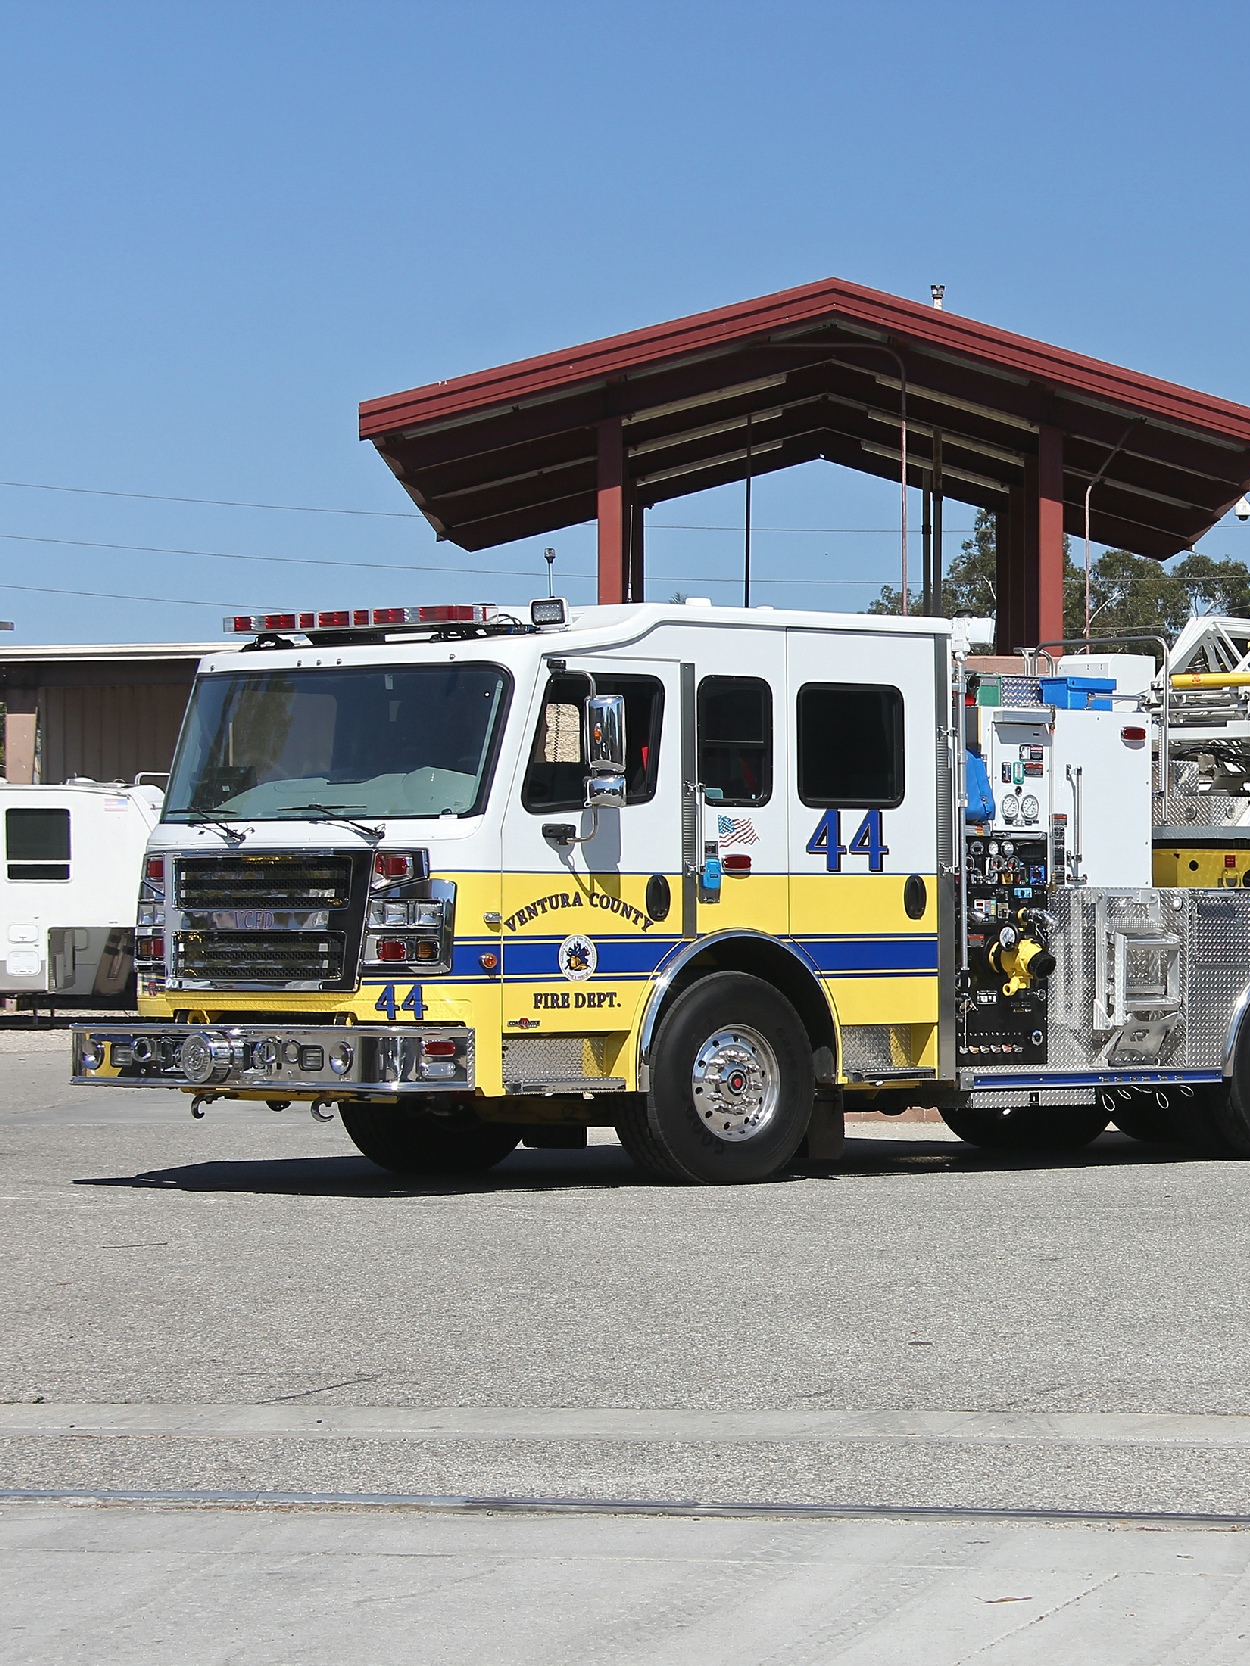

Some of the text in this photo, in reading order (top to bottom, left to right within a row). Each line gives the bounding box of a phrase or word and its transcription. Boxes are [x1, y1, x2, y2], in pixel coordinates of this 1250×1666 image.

[806, 808, 889, 872] 44
[233, 910, 274, 929] VCFD
[504, 891, 655, 932] VENTURA COUNTY
[375, 983, 427, 1020] 44
[533, 991, 622, 1009] FIRE DEPT.
